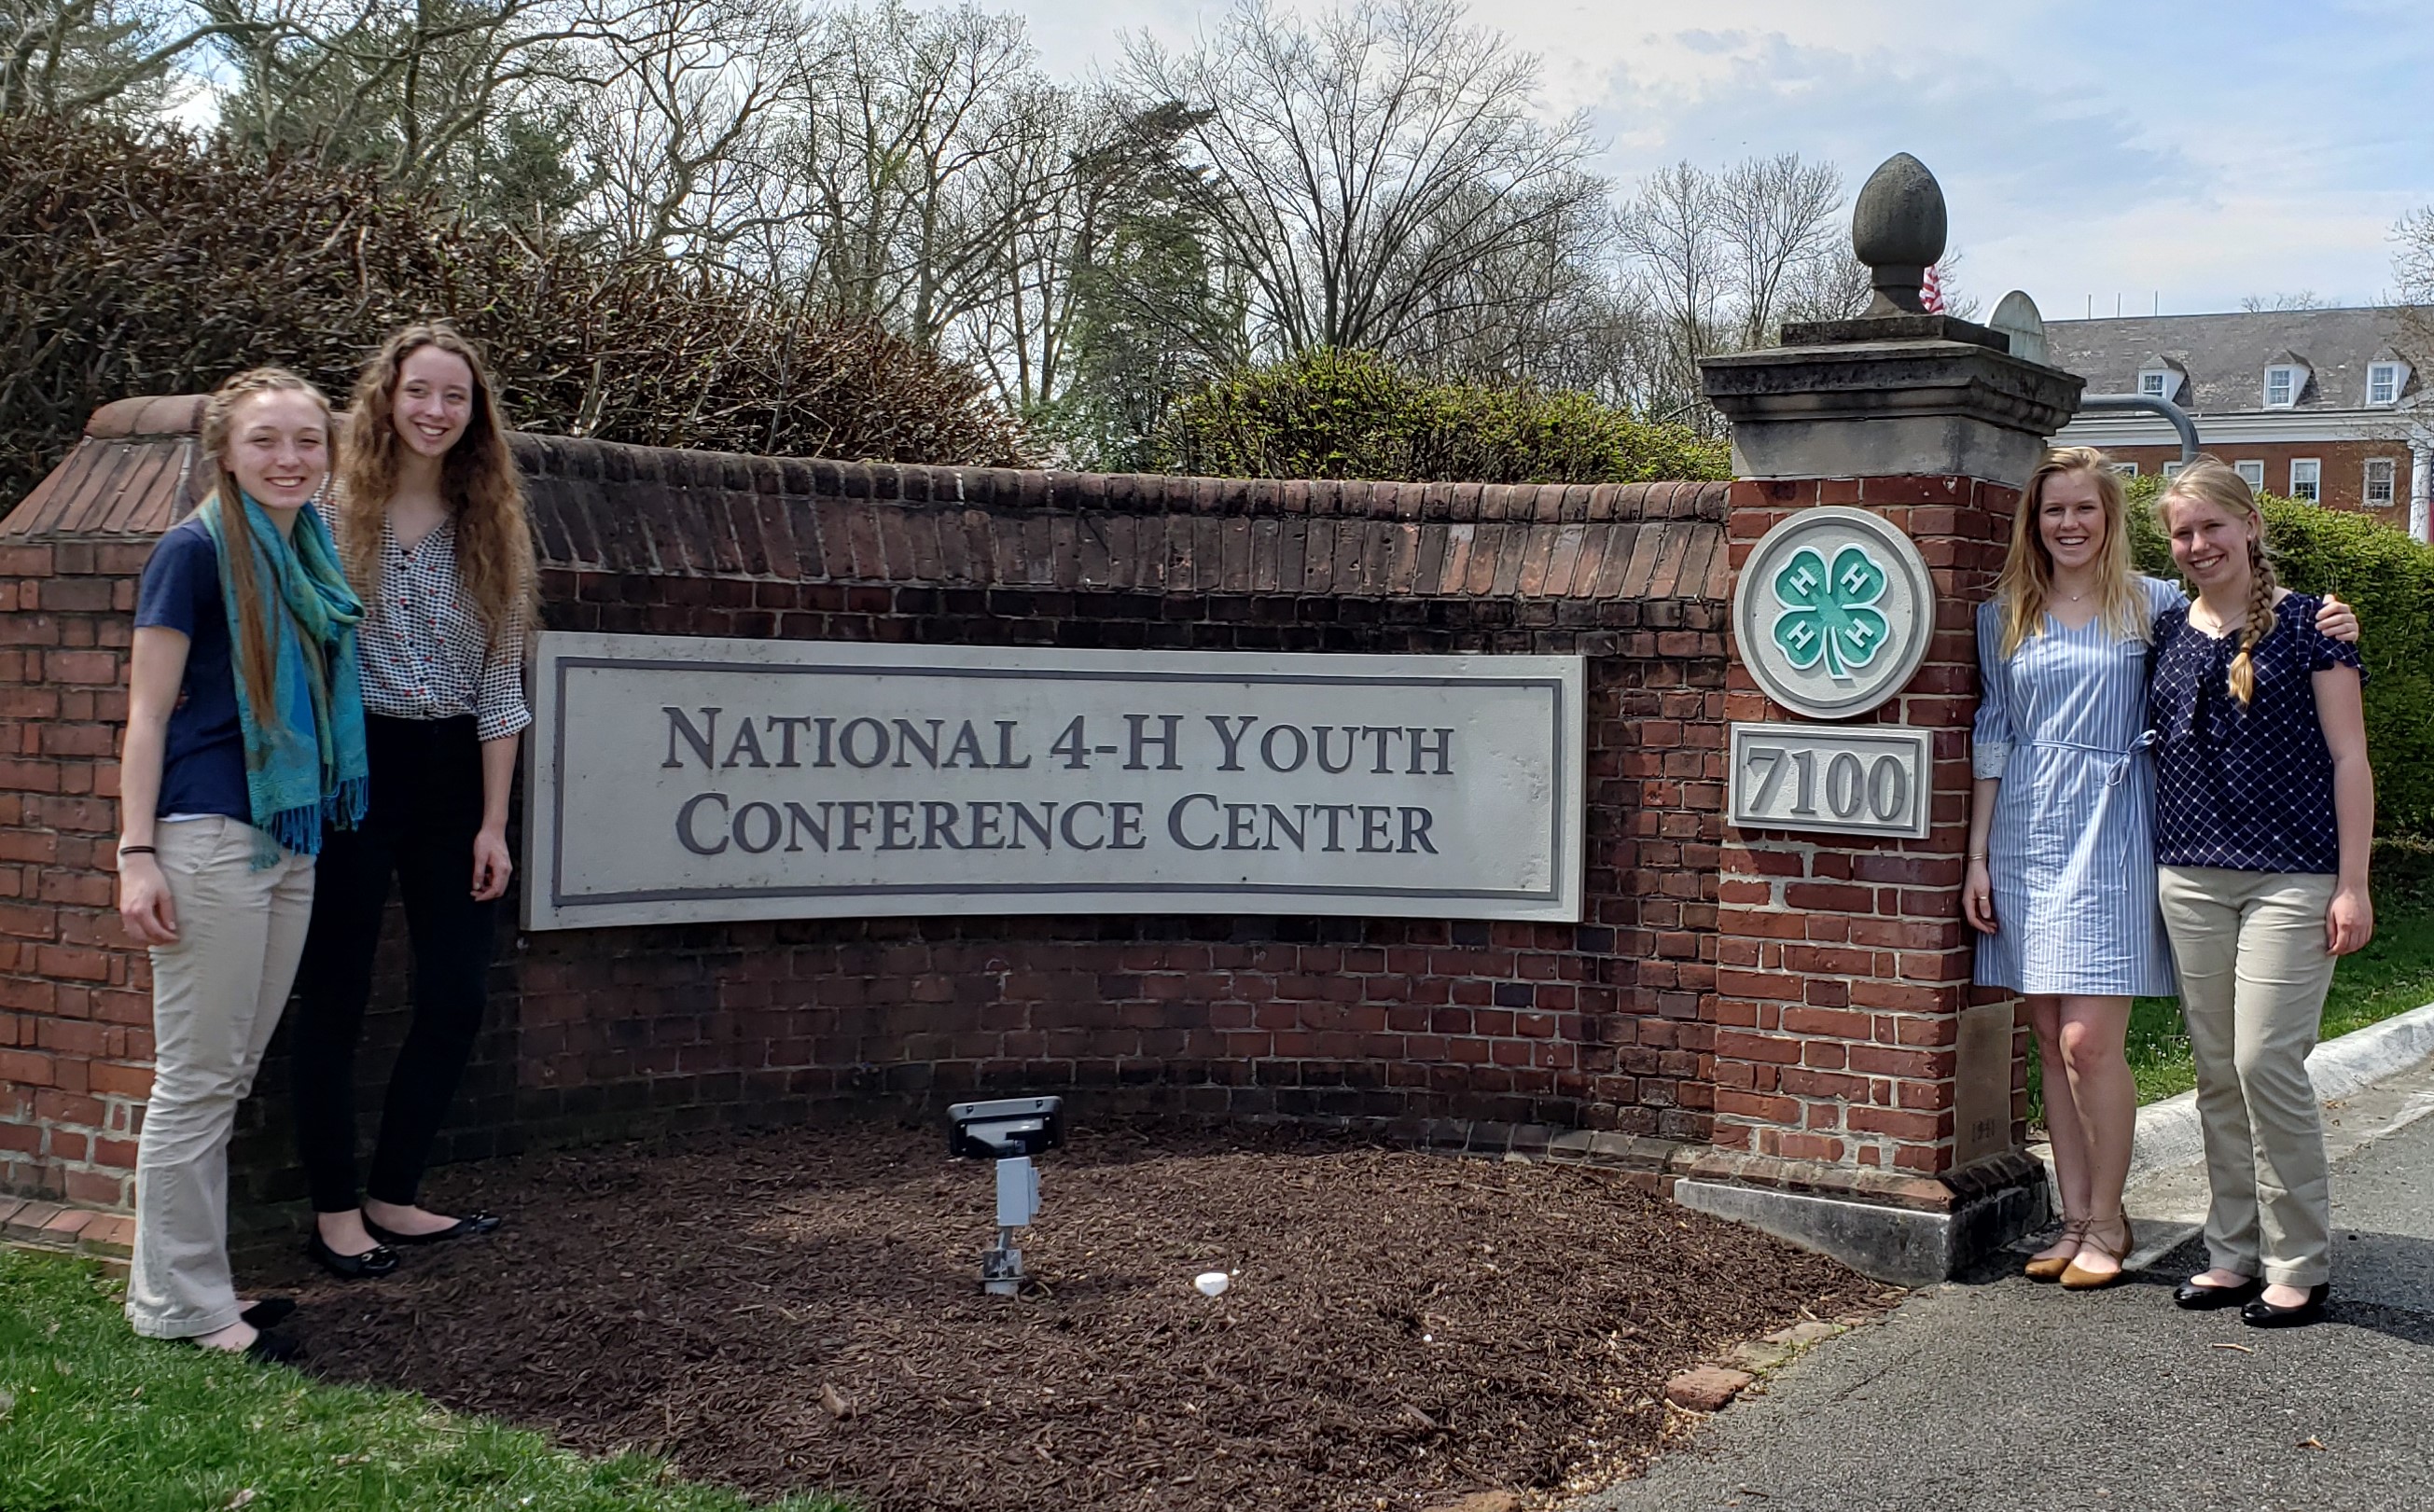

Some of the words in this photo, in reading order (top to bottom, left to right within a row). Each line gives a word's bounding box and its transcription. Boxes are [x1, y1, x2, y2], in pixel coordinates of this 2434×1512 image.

[1789, 566, 1816, 596] H
[1841, 563, 1869, 594] H
[1787, 620, 1815, 650] H
[1845, 618, 1873, 647] H
[661, 706, 1032, 770] NATIONAL
[1047, 714, 1185, 772] 4-H
[1204, 715, 1455, 776] YOUTH
[1747, 747, 1906, 822] 7100
[675, 793, 1147, 855] CONFERENCE
[1167, 794, 1440, 855] CENTER
